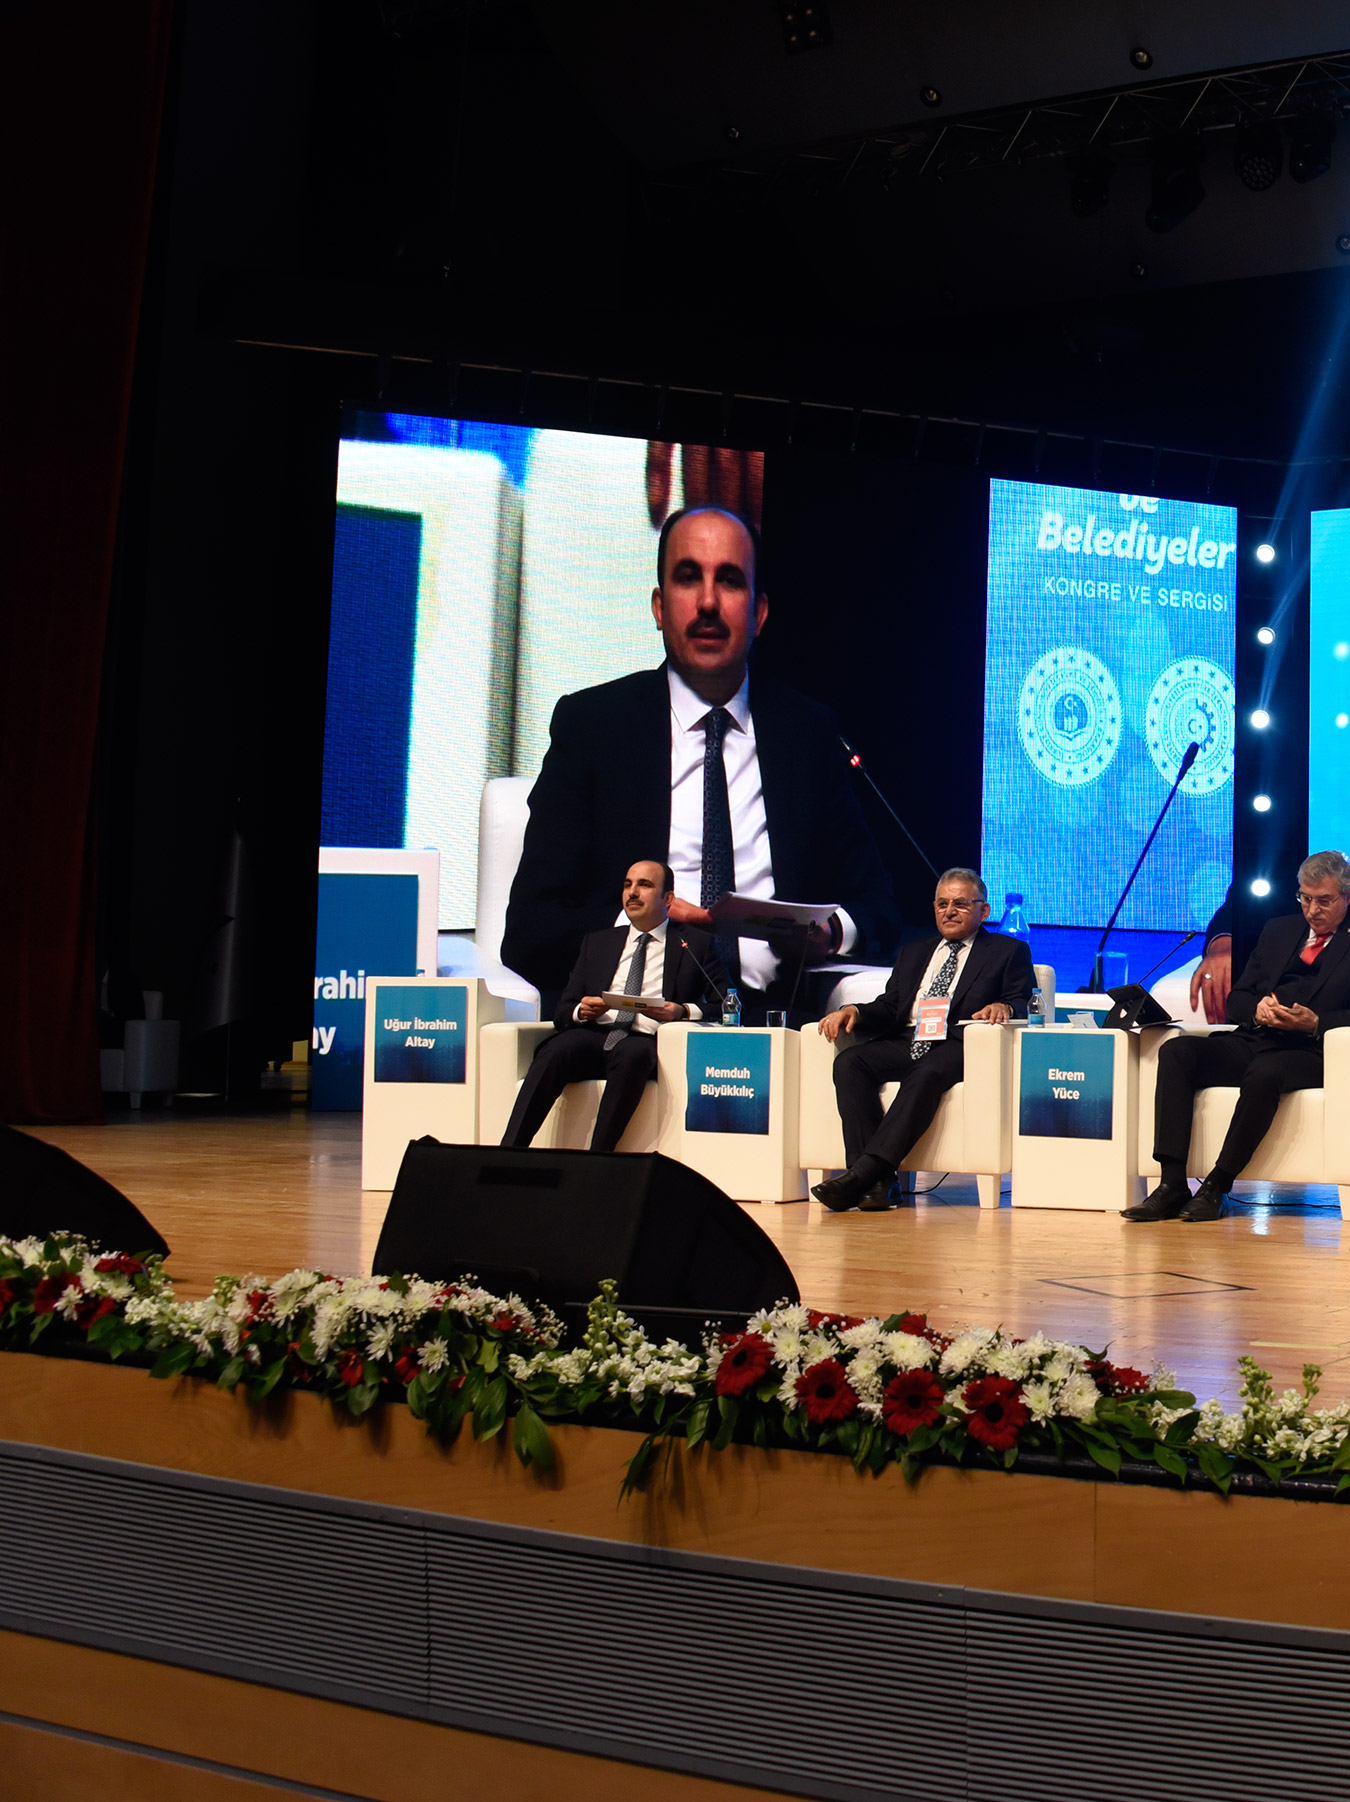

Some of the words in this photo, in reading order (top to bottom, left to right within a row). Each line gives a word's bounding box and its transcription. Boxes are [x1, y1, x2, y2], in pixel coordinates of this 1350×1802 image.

[1037, 512, 1236, 575] Belediyeler
[1045, 576, 1122, 601] KONGRE
[1129, 585, 1151, 604] VE
[314, 970, 365, 1000] rahi
[384, 1018, 411, 1031] Uğur
[412, 1016, 458, 1032] İbrahim
[405, 1035, 436, 1050] Altay
[705, 1066, 751, 1080] Memduh
[1048, 1068, 1085, 1083] Ekrem
[700, 1084, 755, 1100] Büyükkılıç
[1052, 1086, 1080, 1101] Yüce
